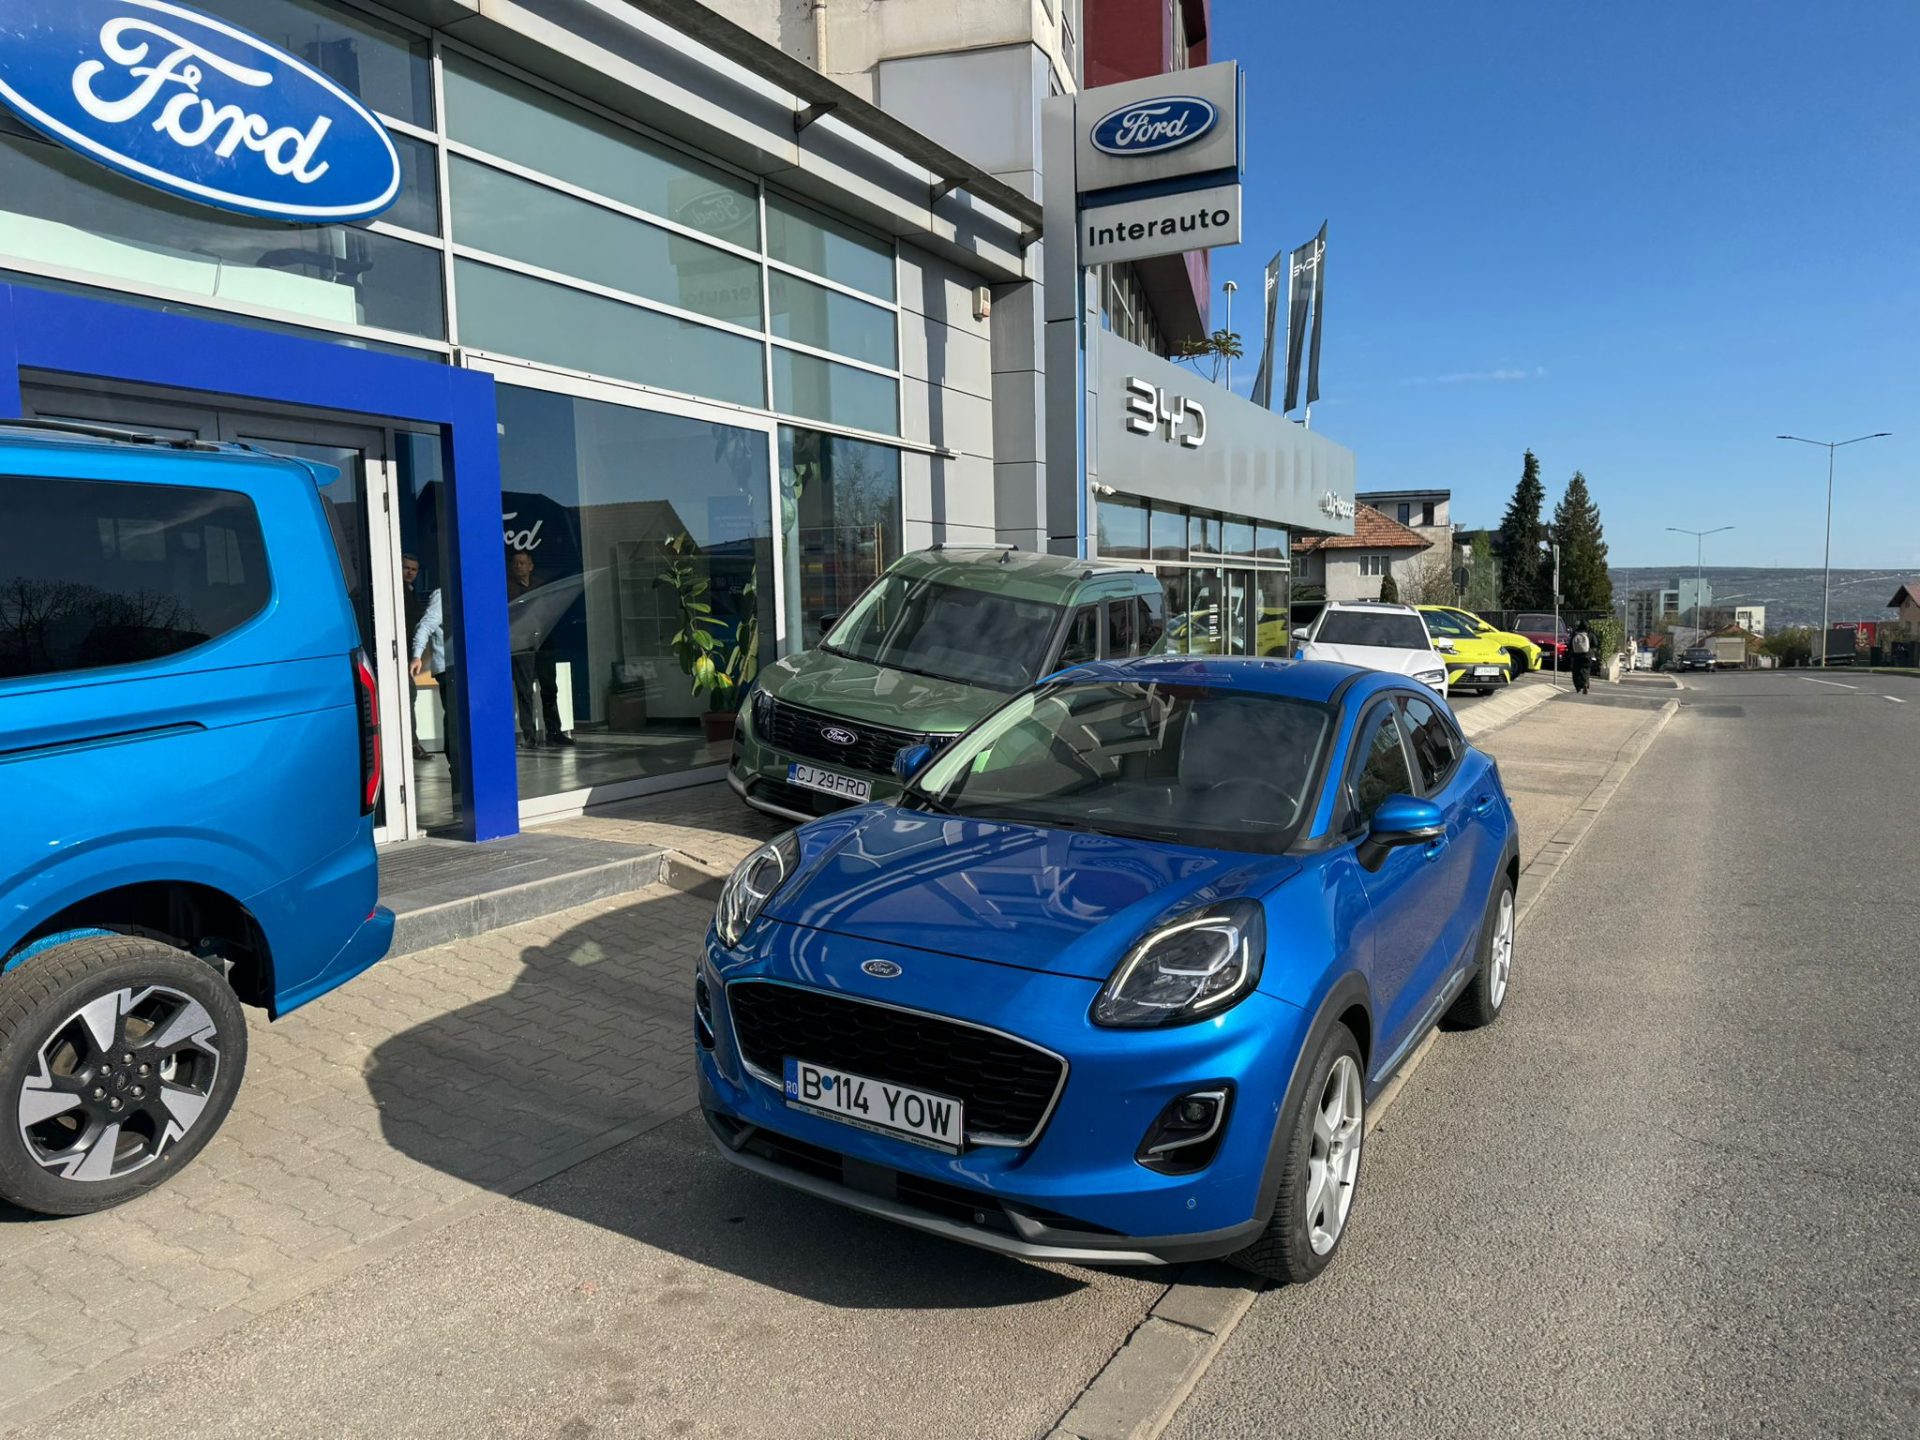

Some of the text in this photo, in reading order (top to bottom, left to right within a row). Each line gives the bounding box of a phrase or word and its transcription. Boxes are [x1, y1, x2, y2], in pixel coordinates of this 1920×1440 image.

[72, 17, 332, 184] Ford
[1115, 105, 1190, 146] Ford
[1089, 208, 1230, 247] Interauto
[1127, 376, 1207, 448] BYD
[827, 728, 849, 743] Ford
[796, 766, 814, 783] CJ
[818, 772, 835, 789] 29
[836, 776, 867, 796] FRD
[785, 1080, 798, 1094] RO
[803, 1066, 822, 1100] B
[832, 1075, 870, 1115] 114
[882, 1086, 952, 1136] YOW
